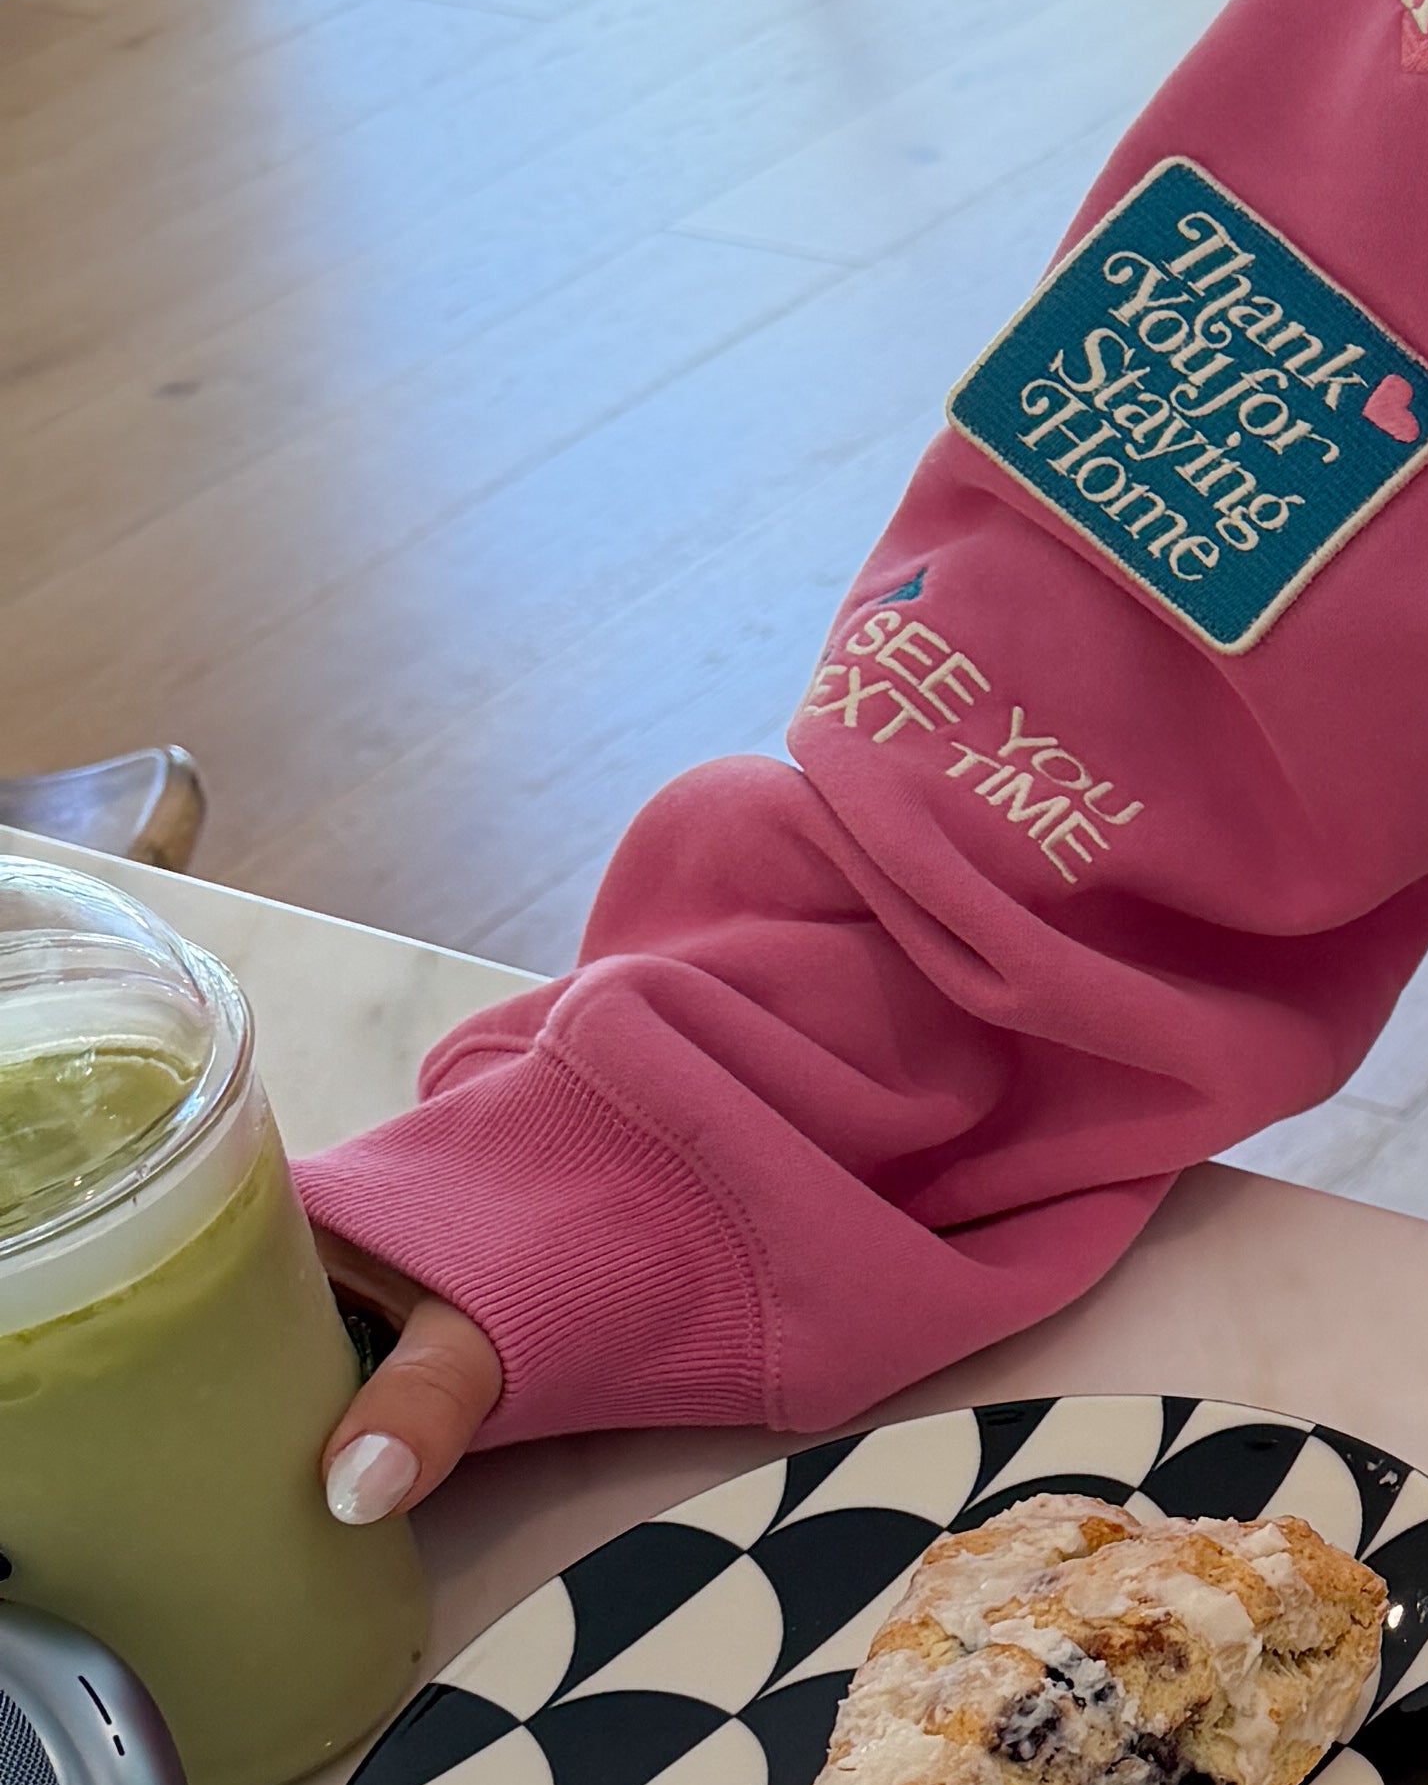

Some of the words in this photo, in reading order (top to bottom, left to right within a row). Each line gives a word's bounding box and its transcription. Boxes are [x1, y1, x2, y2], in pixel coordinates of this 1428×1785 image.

[1103, 251, 1234, 387] You
[1171, 368, 1340, 465] for
[1162, 211, 1369, 412] Thank
[1016, 378, 1220, 584] Home
[1049, 328, 1304, 552] Staying
[804, 665, 936, 744] EXT
[945, 741, 1111, 885] TIME
[846, 610, 991, 724] SEE
[998, 706, 1144, 826] YOU
